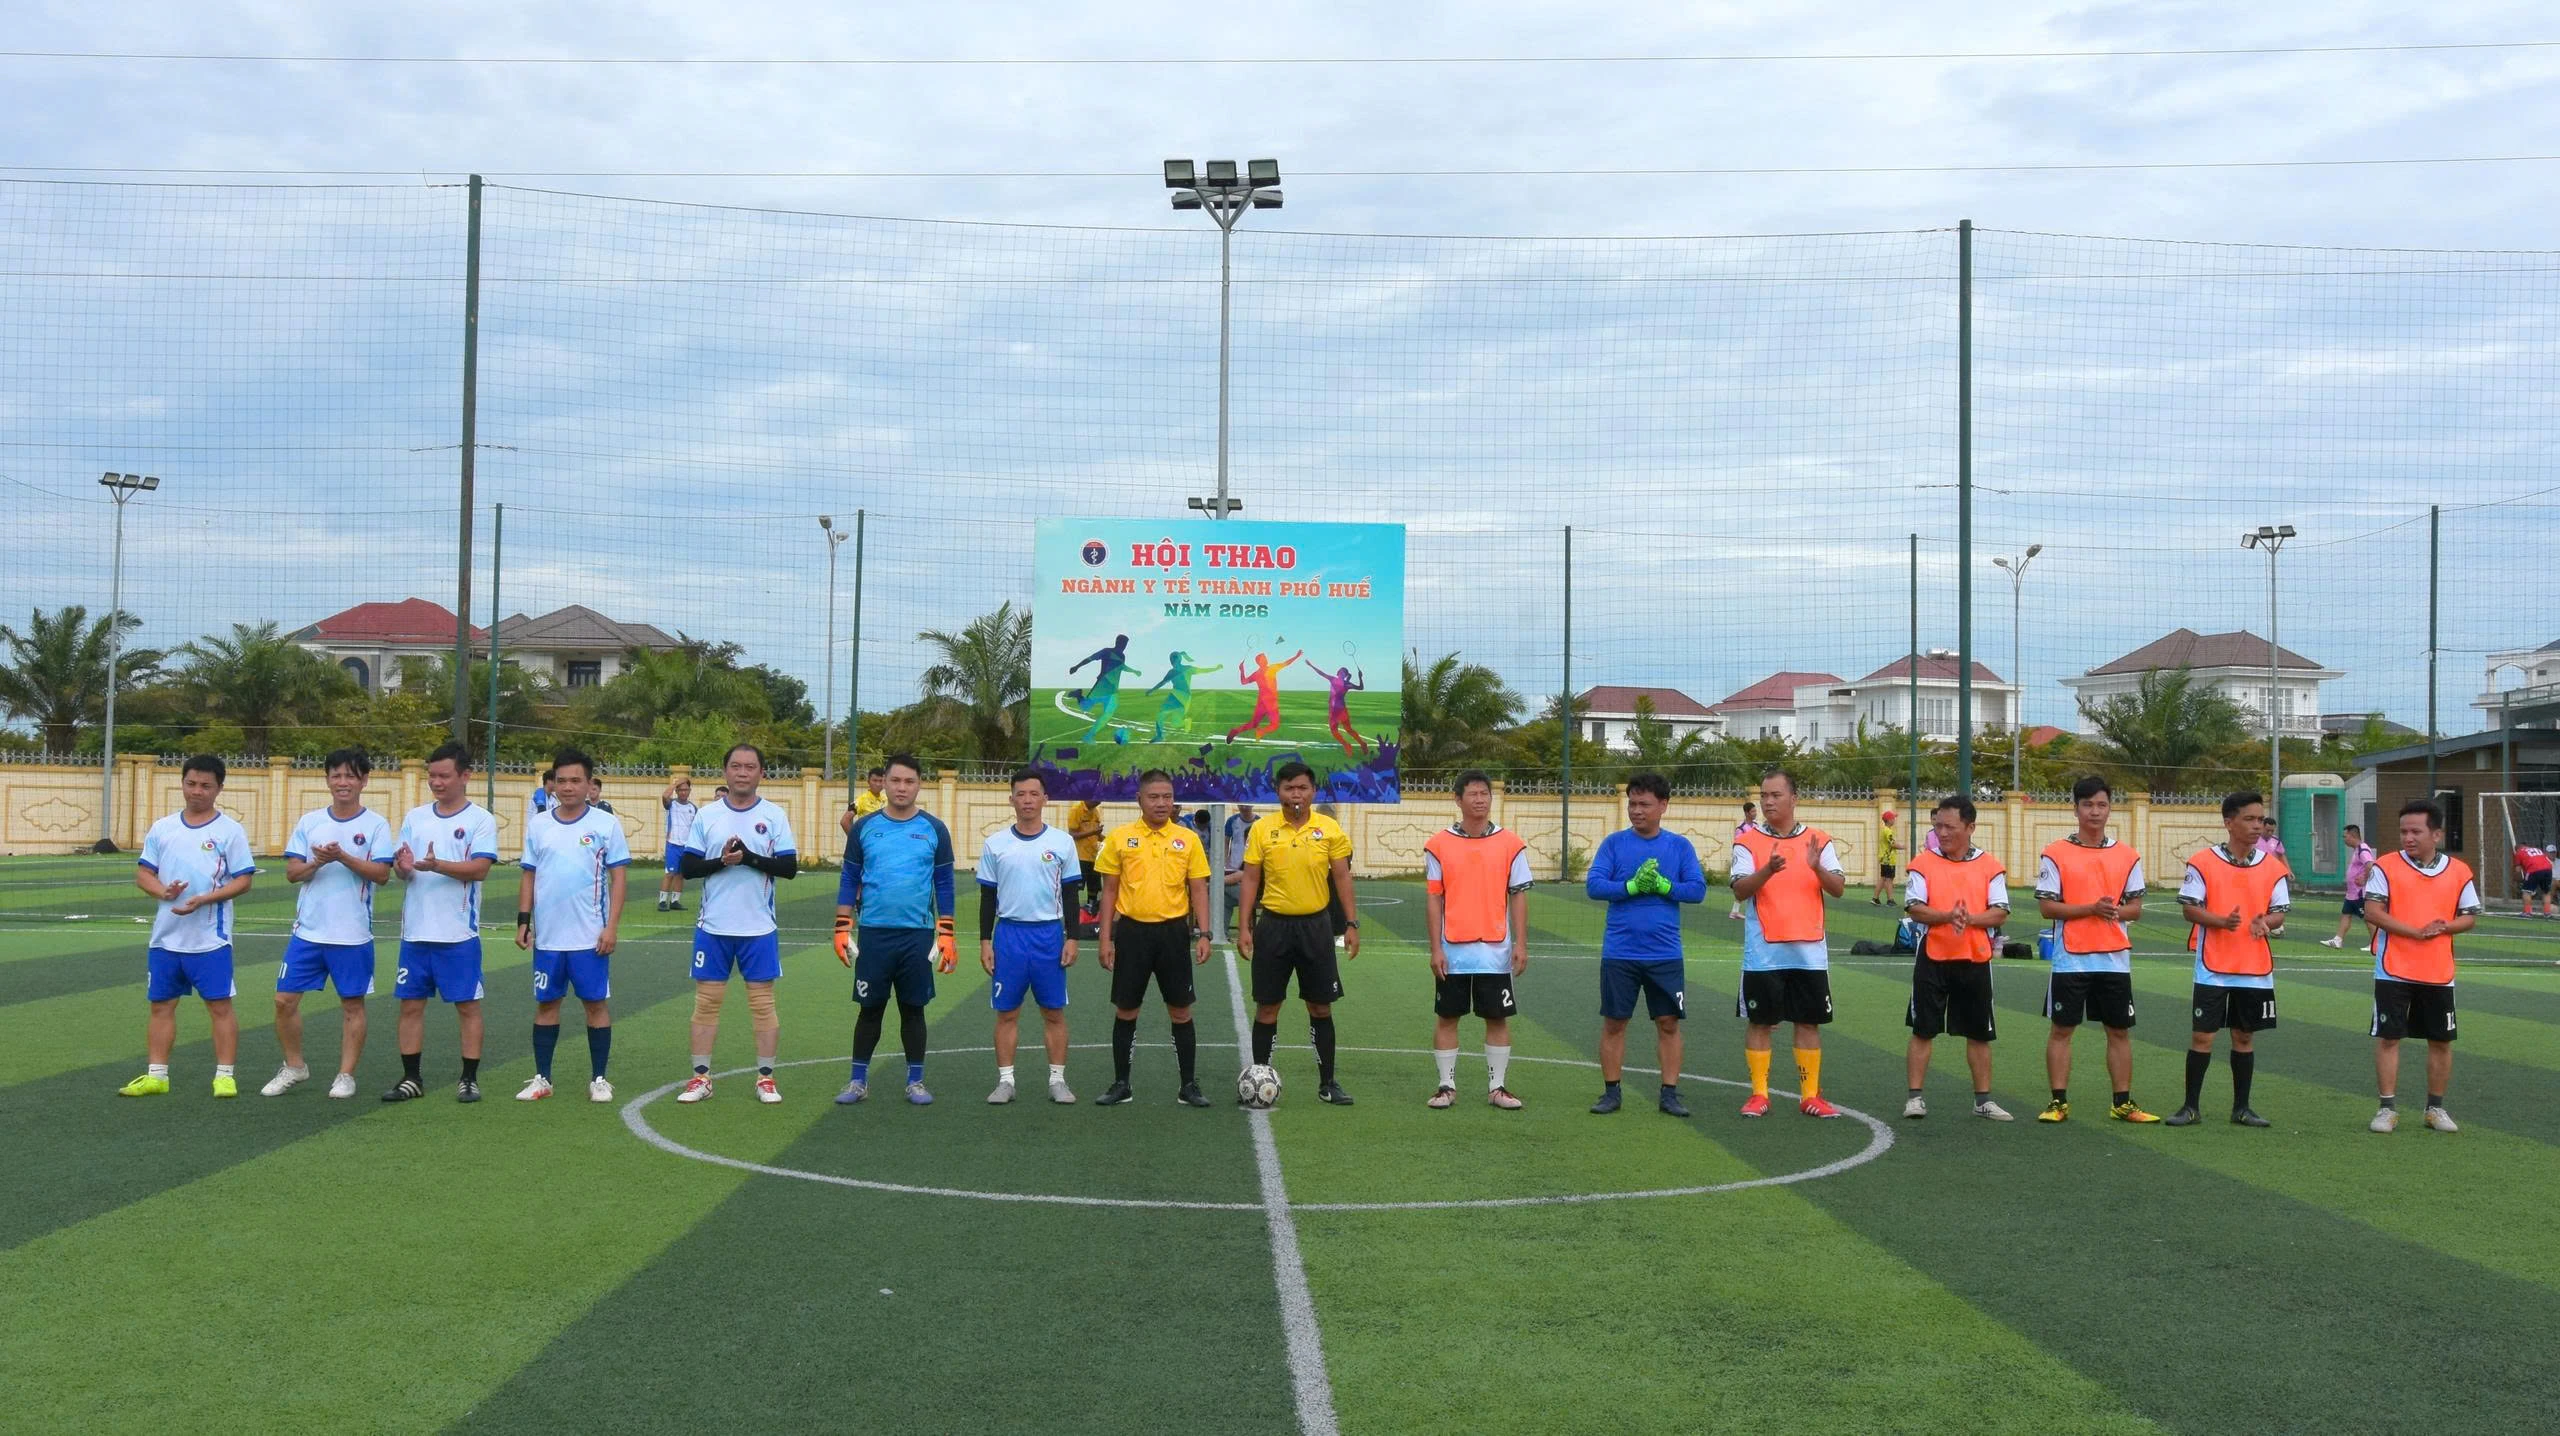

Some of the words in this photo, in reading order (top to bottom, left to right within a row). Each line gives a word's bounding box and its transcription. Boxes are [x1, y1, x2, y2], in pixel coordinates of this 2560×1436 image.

[1131, 538, 1191, 572] HỘI
[1203, 545, 1296, 569] THAO
[1061, 575, 1136, 594] NGÀNH
[1143, 579, 1157, 593] Y
[1163, 572, 1191, 594] TẾ
[1198, 576, 1272, 596] THÀNH
[1279, 575, 1321, 597] PHỐ
[1328, 576, 1371, 598] HUẾ
[1164, 599, 1211, 617] NĂM
[1219, 603, 1269, 618] 2026
[694, 950, 705, 968] 9
[534, 970, 548, 990] 20
[994, 981, 1002, 998] 7
[1501, 988, 1513, 1008] 2
[2261, 1000, 2276, 1019] 11
